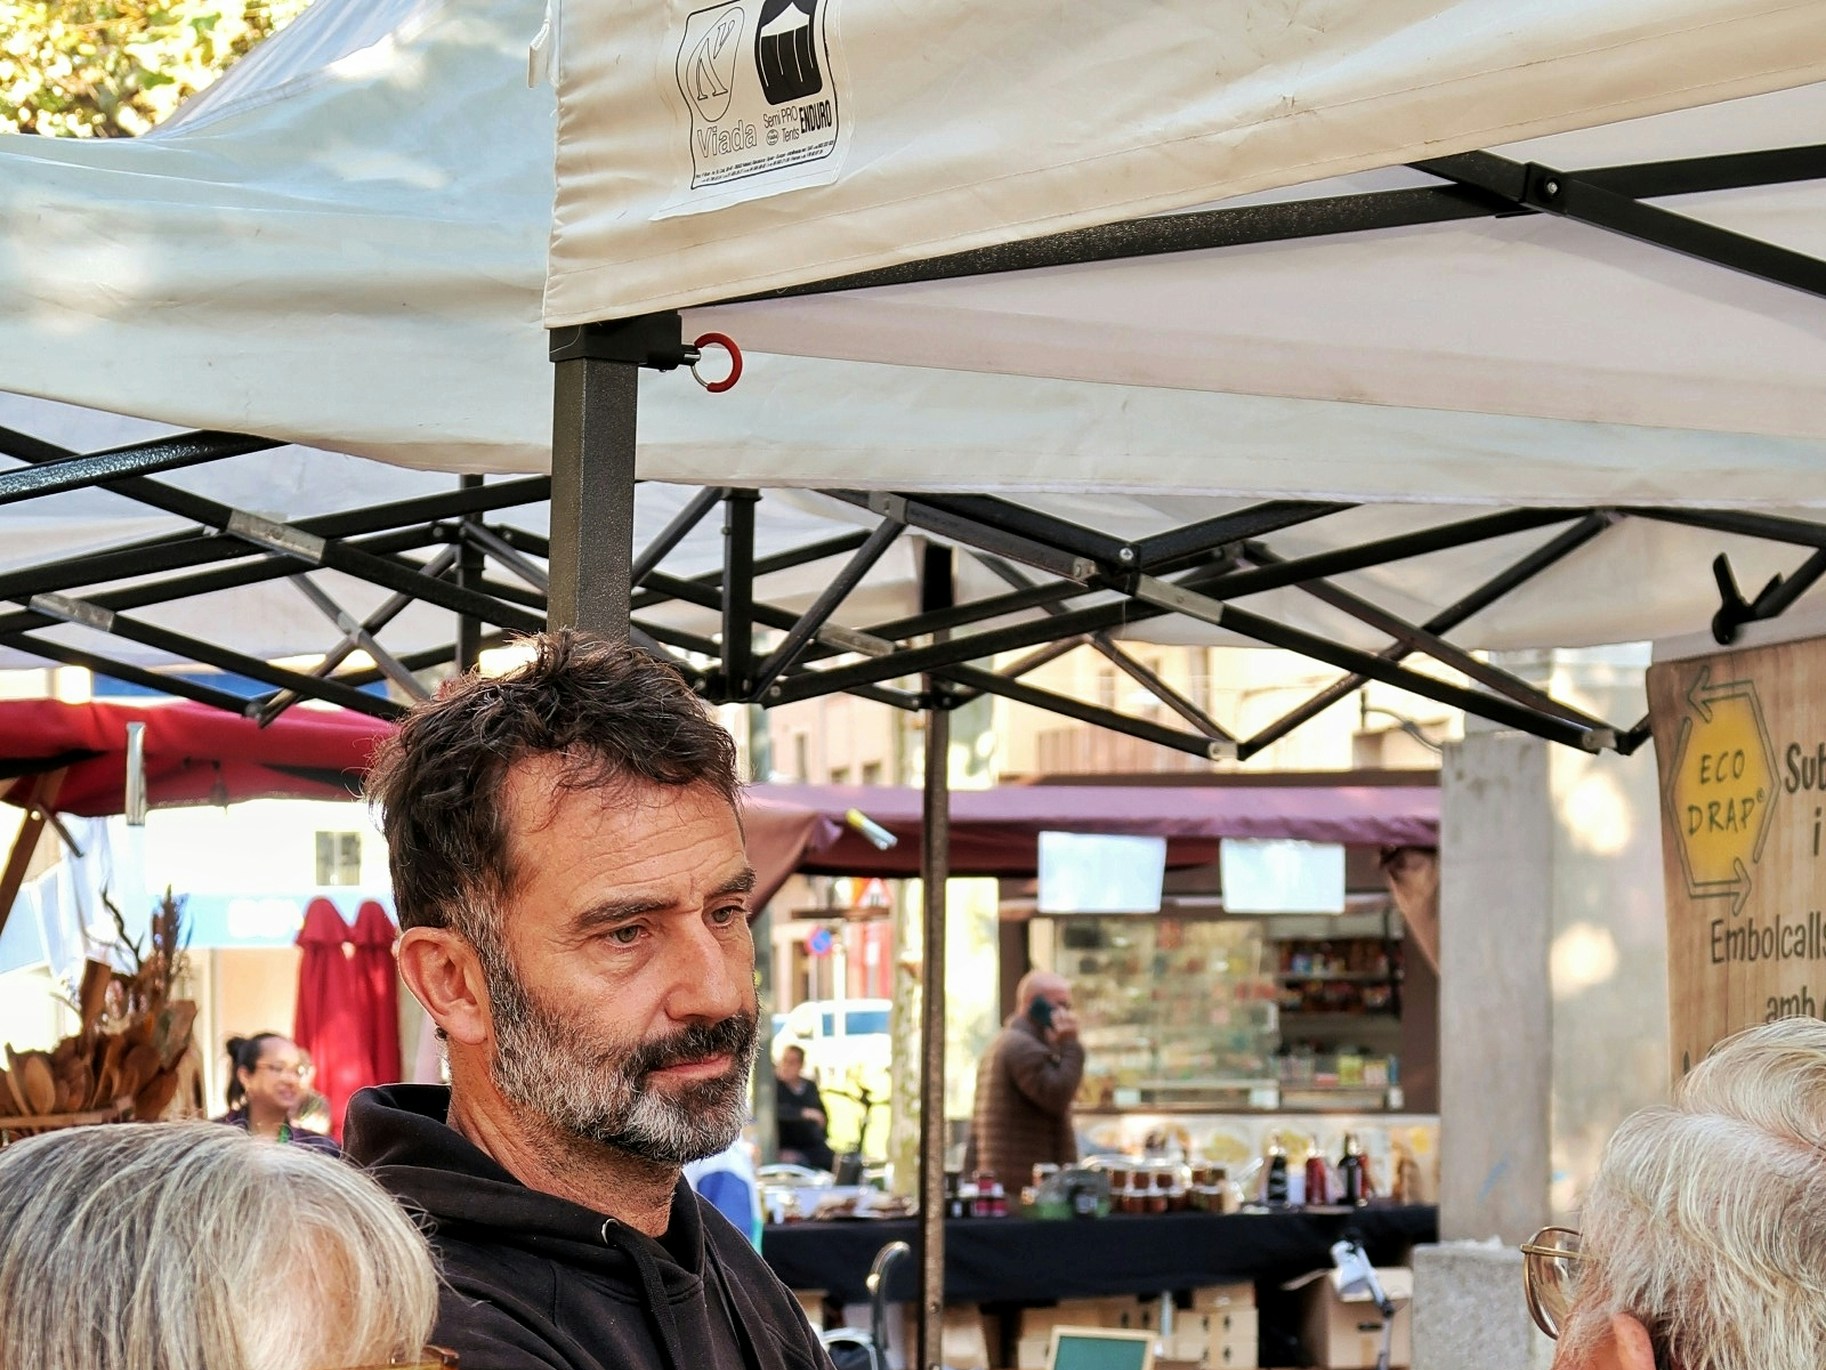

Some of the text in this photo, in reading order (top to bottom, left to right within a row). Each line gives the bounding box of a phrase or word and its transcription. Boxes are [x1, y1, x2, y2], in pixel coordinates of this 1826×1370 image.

[763, 105, 798, 129] Semi PRO
[799, 99, 832, 134] ENDURO
[697, 119, 757, 158] Viada
[781, 126, 800, 143] Tents
[1700, 749, 1745, 785] ECO
[1813, 806, 1823, 856] i
